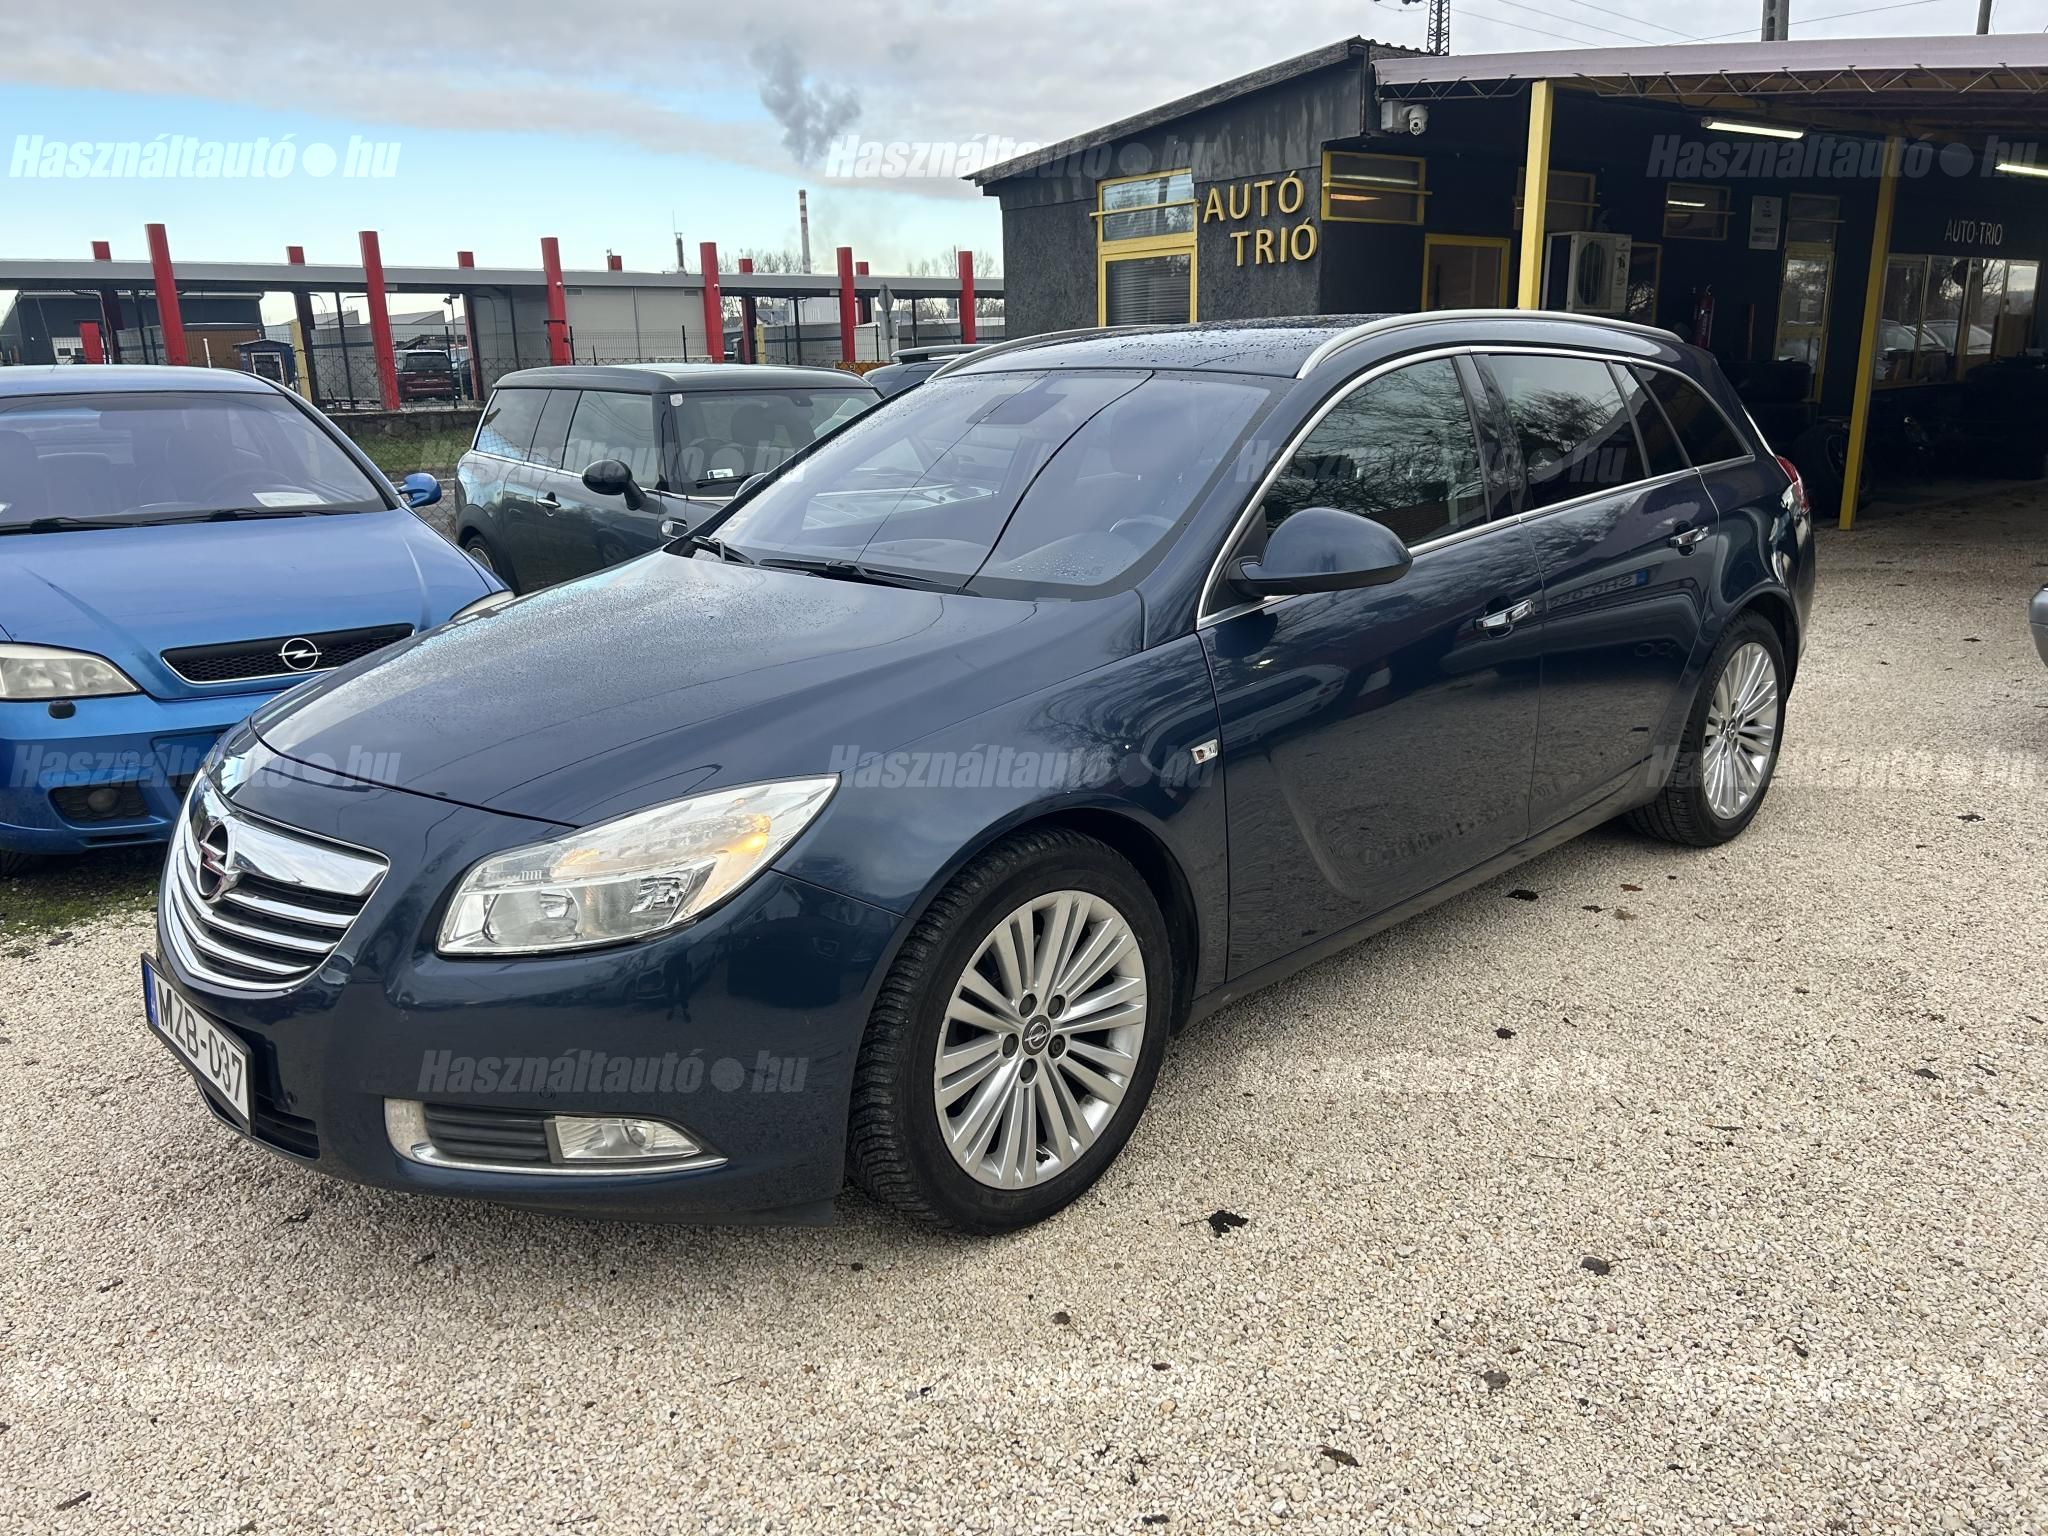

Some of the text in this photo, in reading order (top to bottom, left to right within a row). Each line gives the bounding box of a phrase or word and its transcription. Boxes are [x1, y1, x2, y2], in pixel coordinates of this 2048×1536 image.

[1203, 170, 1305, 223] AUTÓ
[1230, 217, 1318, 266] TRIÓ
[156, 981, 243, 1101] MZB-037
